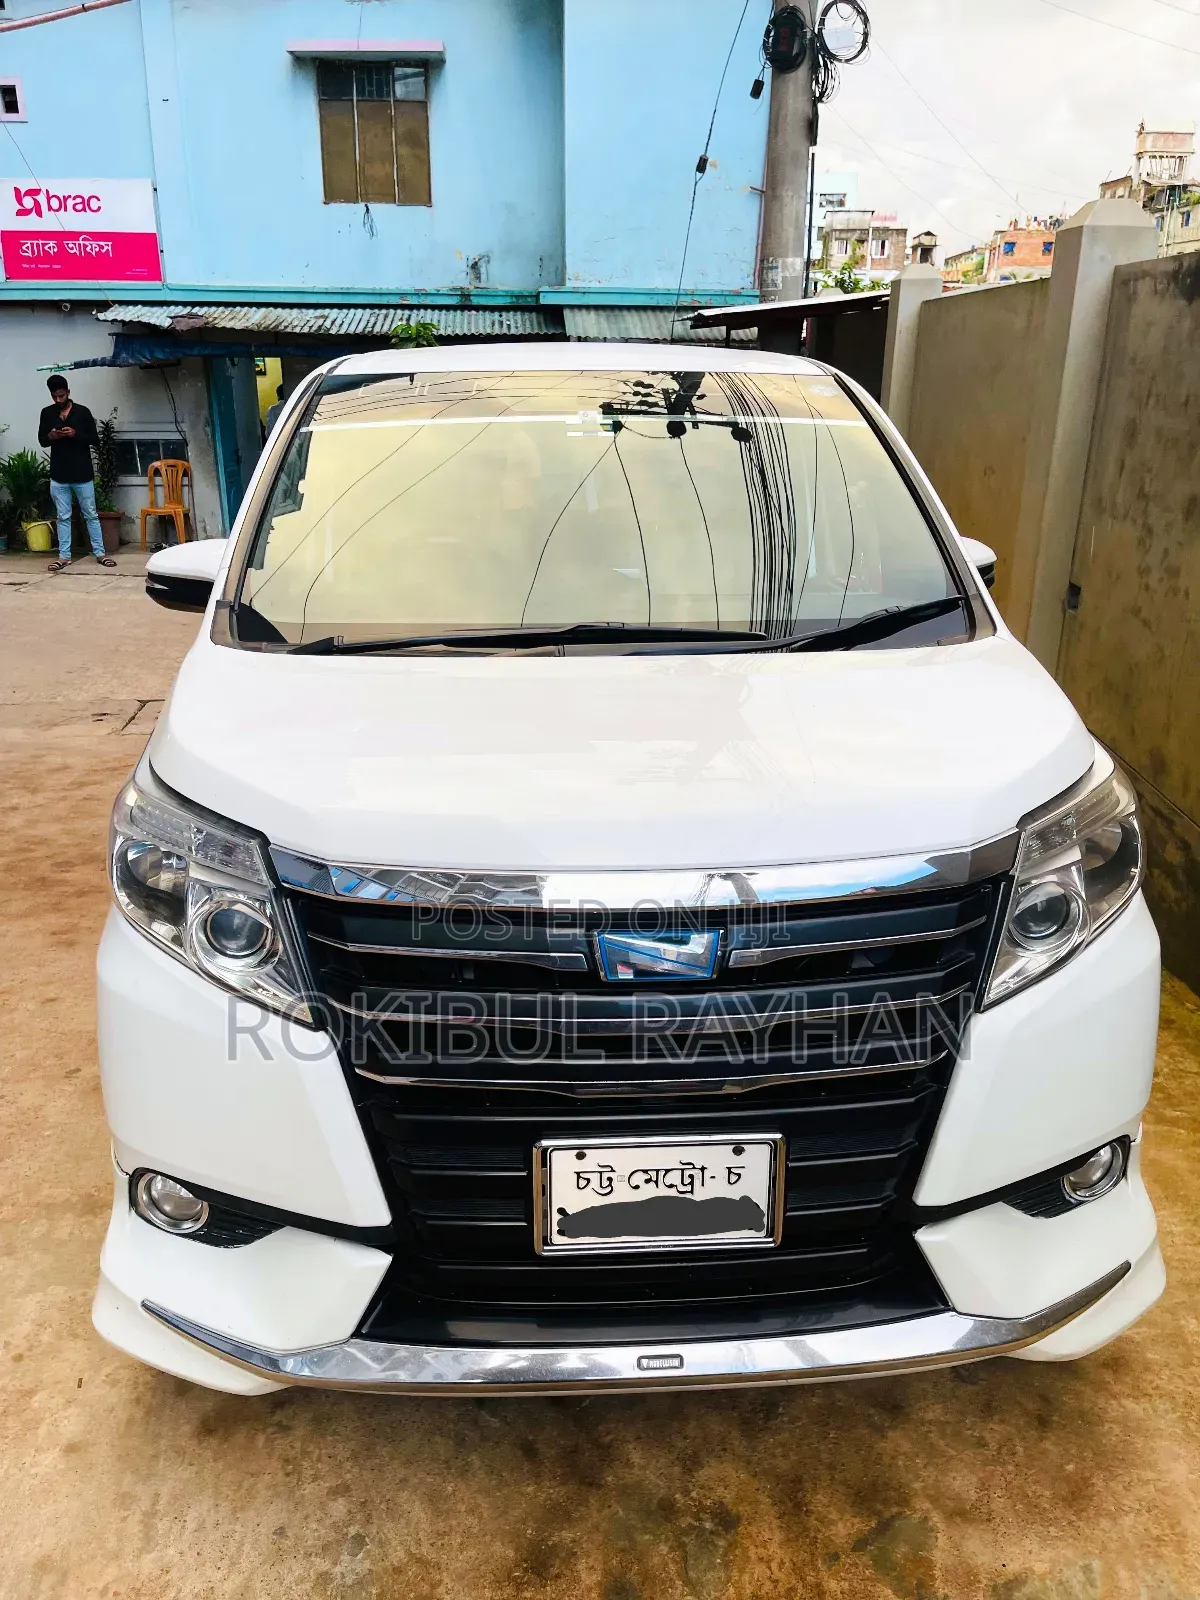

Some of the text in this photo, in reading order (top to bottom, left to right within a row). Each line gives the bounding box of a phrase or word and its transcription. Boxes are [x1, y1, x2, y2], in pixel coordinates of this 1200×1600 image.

[46, 189, 102, 213] brac
[19, 235, 113, 258] ব্র্যাক অফিস
